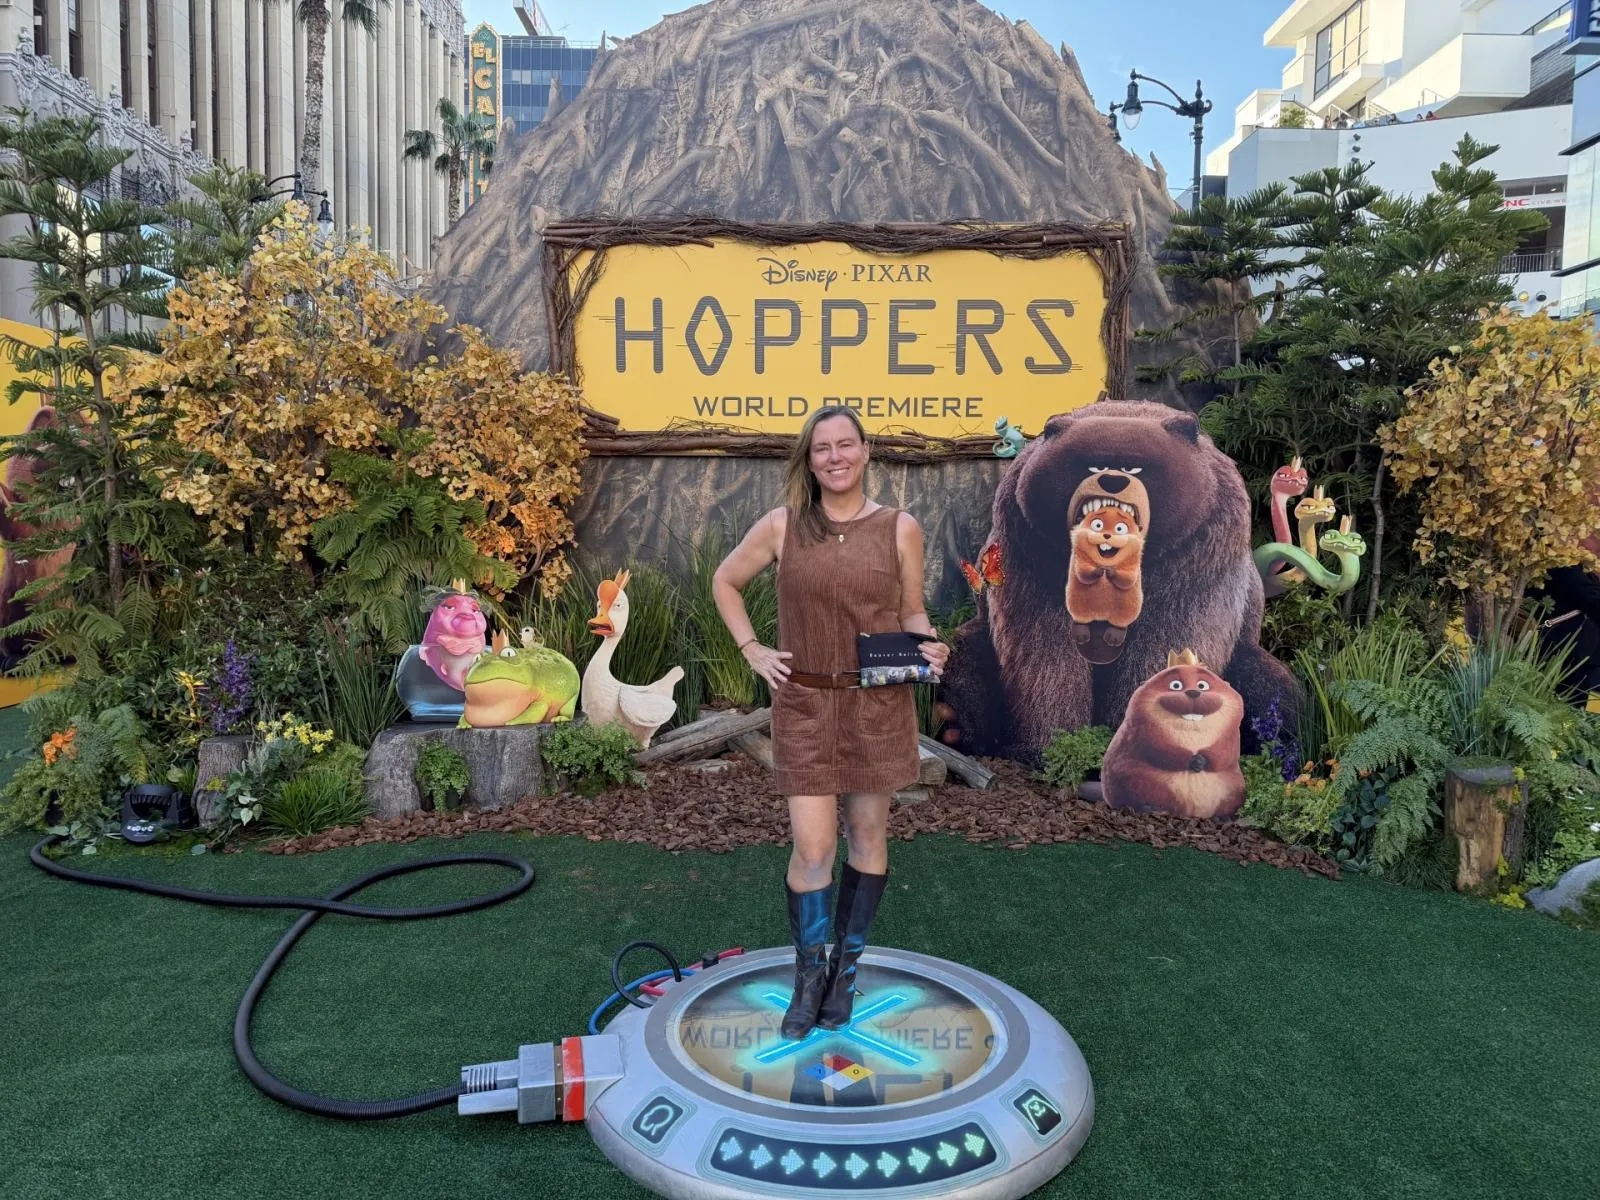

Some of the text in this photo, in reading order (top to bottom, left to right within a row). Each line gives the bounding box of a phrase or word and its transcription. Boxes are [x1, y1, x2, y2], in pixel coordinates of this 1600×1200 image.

[471, 42, 496, 63] EL
[756, 257, 932, 292] Disney PIXAR
[614, 296, 1075, 376] HOPPERS
[692, 396, 809, 417] WORLD
